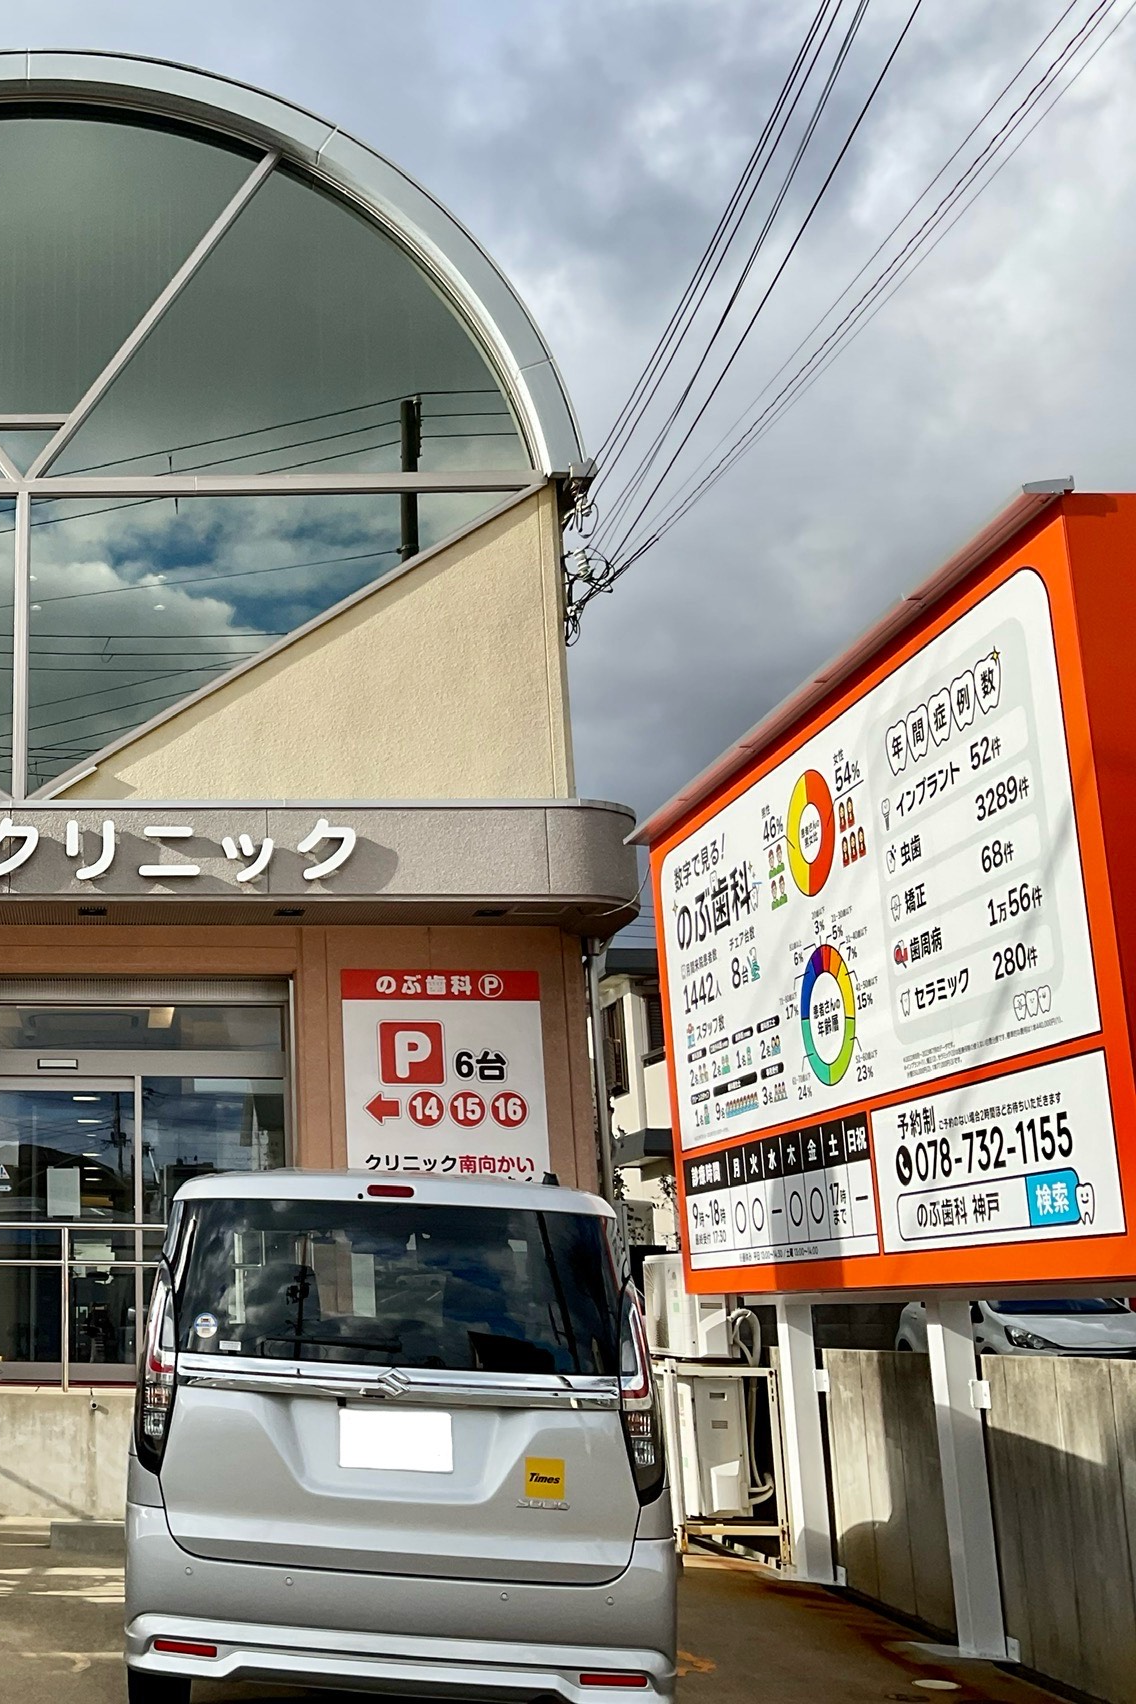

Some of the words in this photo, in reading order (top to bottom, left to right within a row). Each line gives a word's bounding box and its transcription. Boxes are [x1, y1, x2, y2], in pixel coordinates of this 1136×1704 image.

[891, 666, 996, 760] 年間症例数
[835, 760, 860, 792] 54%
[896, 761, 960, 818] インプラント
[970, 735, 1002, 770] 52件
[974, 775, 1030, 822] 3289件
[763, 815, 784, 842] 46%
[900, 834, 922, 867] 虫歯
[981, 839, 1014, 873] 68件
[676, 860, 751, 951] のぶ歯科
[904, 882, 927, 915] 矯正
[987, 883, 1043, 927] 1万56件
[909, 926, 943, 963] 歯周病
[992, 942, 1039, 981] 280件
[731, 957, 749, 990] 8台
[914, 967, 969, 1010] セラミック
[683, 971, 722, 1014] 1442人
[857, 992, 873, 1010] 15%
[786, 1004, 799, 1020] 17%
[394, 1030, 432, 1079] P
[455, 1050, 507, 1081] 6台
[857, 1064, 874, 1082] 23%
[798, 1085, 812, 1100] 24%
[897, 1105, 936, 1140] 予約制
[365, 1154, 535, 1174] クリニック南向かい
[690, 1161, 721, 1188] 診療時間
[732, 1157, 741, 1178] 月
[749, 1153, 759, 1174] 火
[767, 1148, 777, 1170] 水
[787, 1144, 796, 1166] 木
[806, 1139, 817, 1161] 金
[828, 1133, 839, 1157] 土
[846, 1126, 867, 1153] 日祝
[915, 1111, 1073, 1182] 078-732-1155
[916, 1196, 968, 1228] のぶ歯科
[972, 1192, 1000, 1224] 神戸
[1035, 1181, 1070, 1216] 検索
[833, 1208, 847, 1226] まで
[529, 1472, 561, 1484] Times
